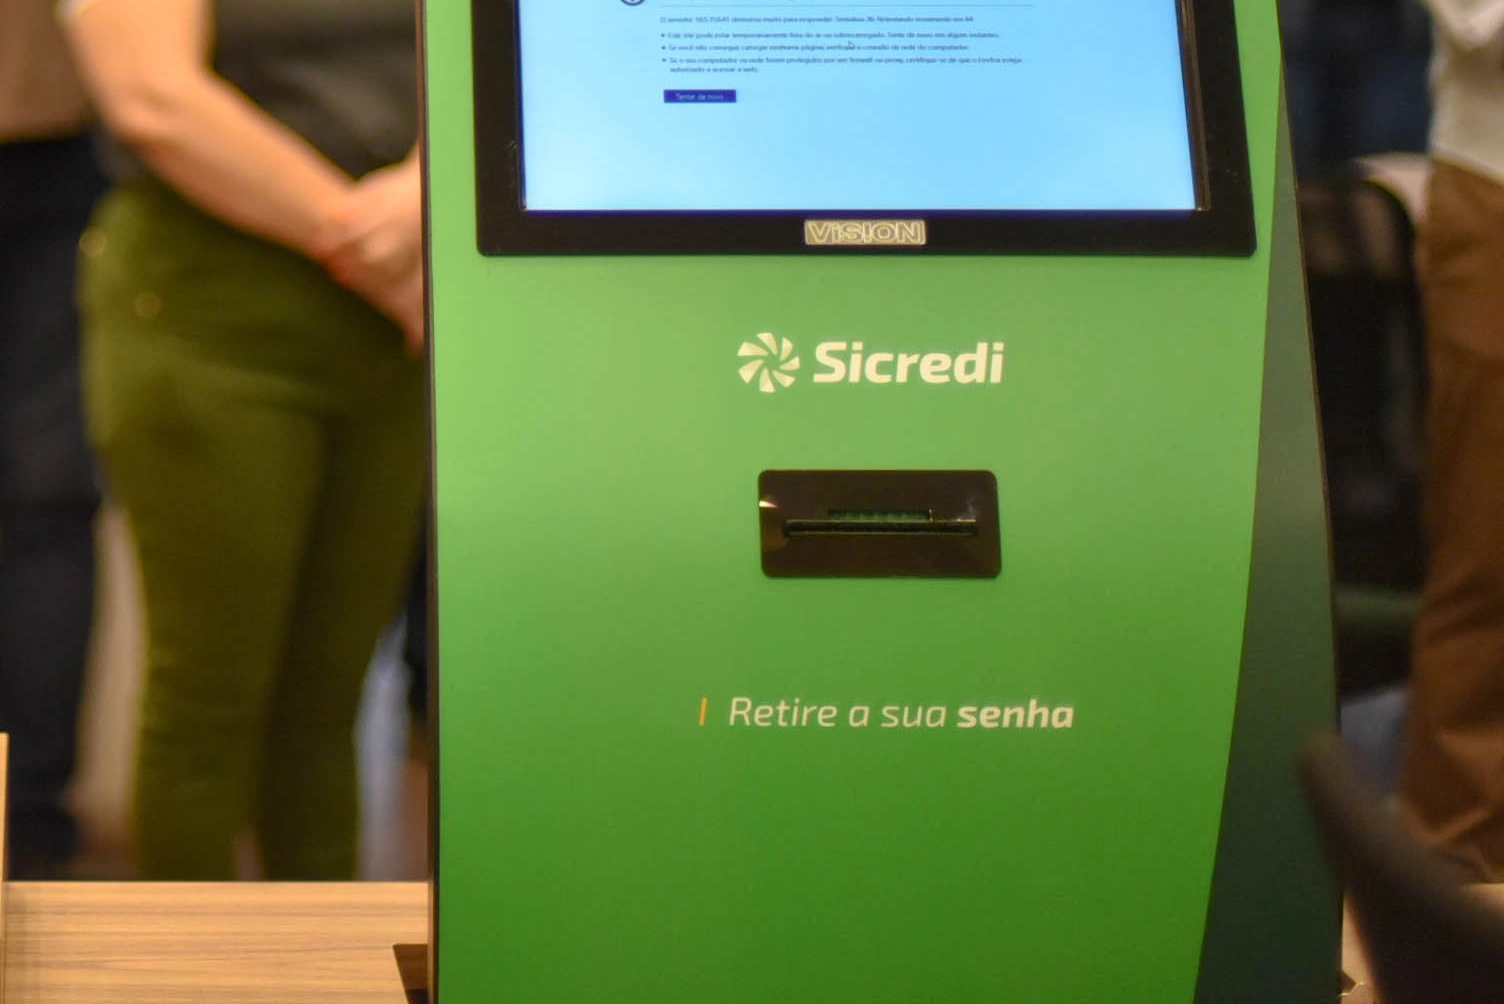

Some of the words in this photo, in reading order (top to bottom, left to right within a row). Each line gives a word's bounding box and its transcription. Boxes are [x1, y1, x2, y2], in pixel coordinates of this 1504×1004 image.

[812, 341, 1006, 384] Sicredi
[729, 697, 838, 727] Retire
[848, 705, 870, 727] a
[880, 705, 947, 728] sua
[956, 699, 1075, 728] senha
